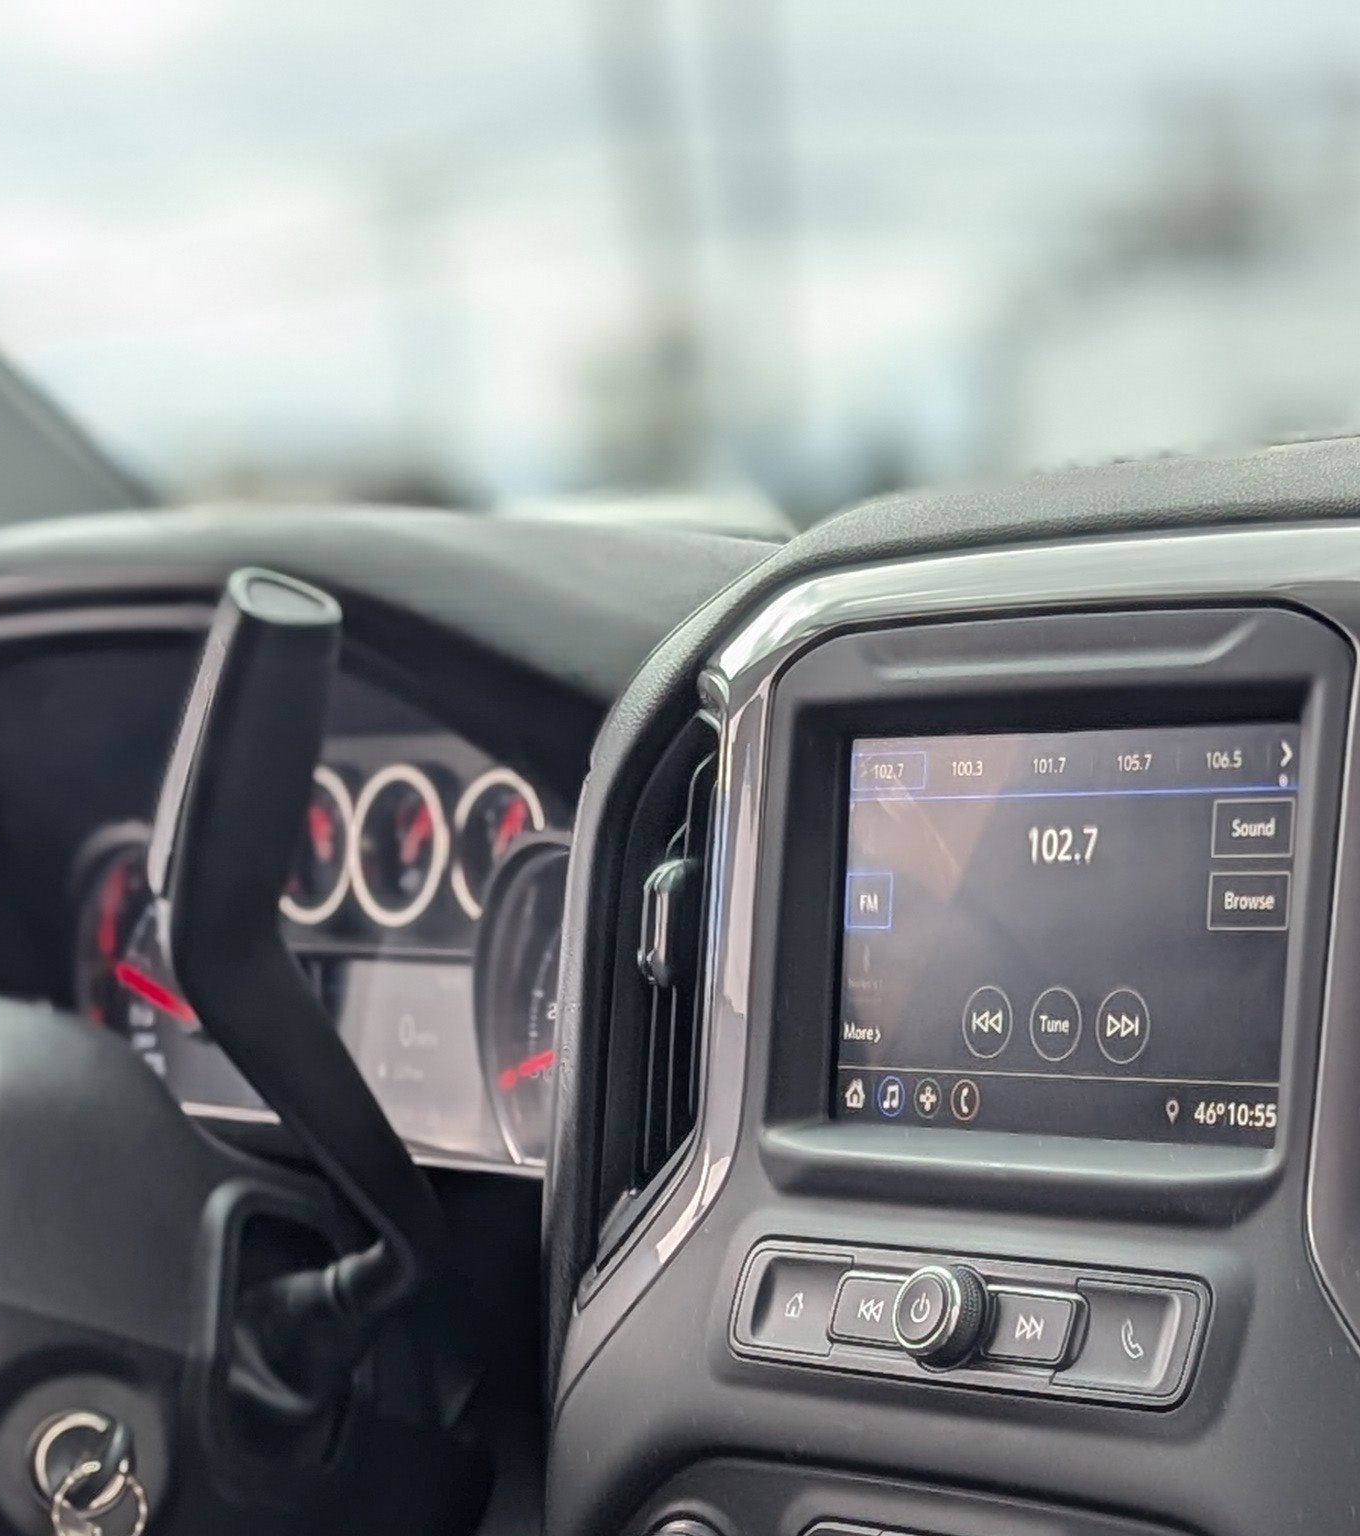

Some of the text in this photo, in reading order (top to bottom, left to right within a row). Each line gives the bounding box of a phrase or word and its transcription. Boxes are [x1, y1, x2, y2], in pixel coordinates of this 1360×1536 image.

[951, 760, 983, 776] 100.3
[1033, 756, 1066, 773] 101.7
[1117, 754, 1153, 771] 105.7
[1206, 750, 1242, 768] 106.5
[873, 763, 904, 780] 102.7
[1231, 817, 1276, 837] Sound
[1028, 826, 1099, 864] 102.7
[859, 892, 879, 914] FM
[1223, 890, 1275, 910] Browse
[843, 1020, 874, 1041] More
[1039, 1014, 1070, 1034] Tune
